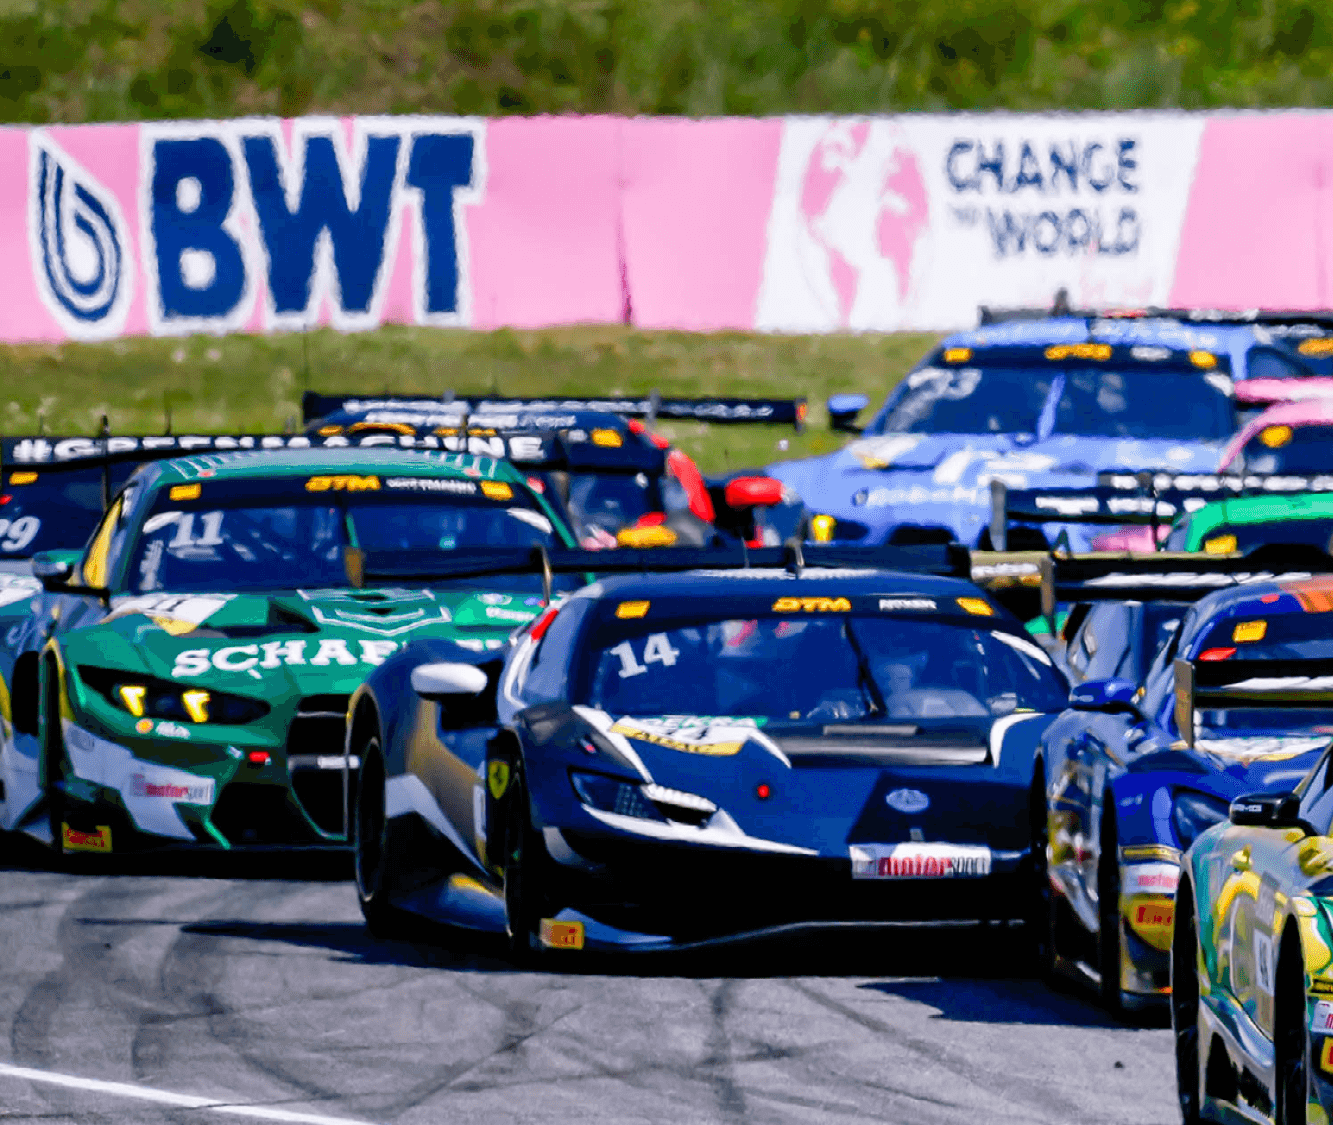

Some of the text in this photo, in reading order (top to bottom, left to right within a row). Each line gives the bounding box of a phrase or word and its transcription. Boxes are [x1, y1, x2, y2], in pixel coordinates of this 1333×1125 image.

[946, 138, 1138, 193] CHANGE
[151, 132, 476, 321] BWT
[984, 206, 1141, 257] WORLD
[168, 512, 224, 547] 11
[772, 597, 852, 612] DTM
[610, 633, 679, 678] 14
